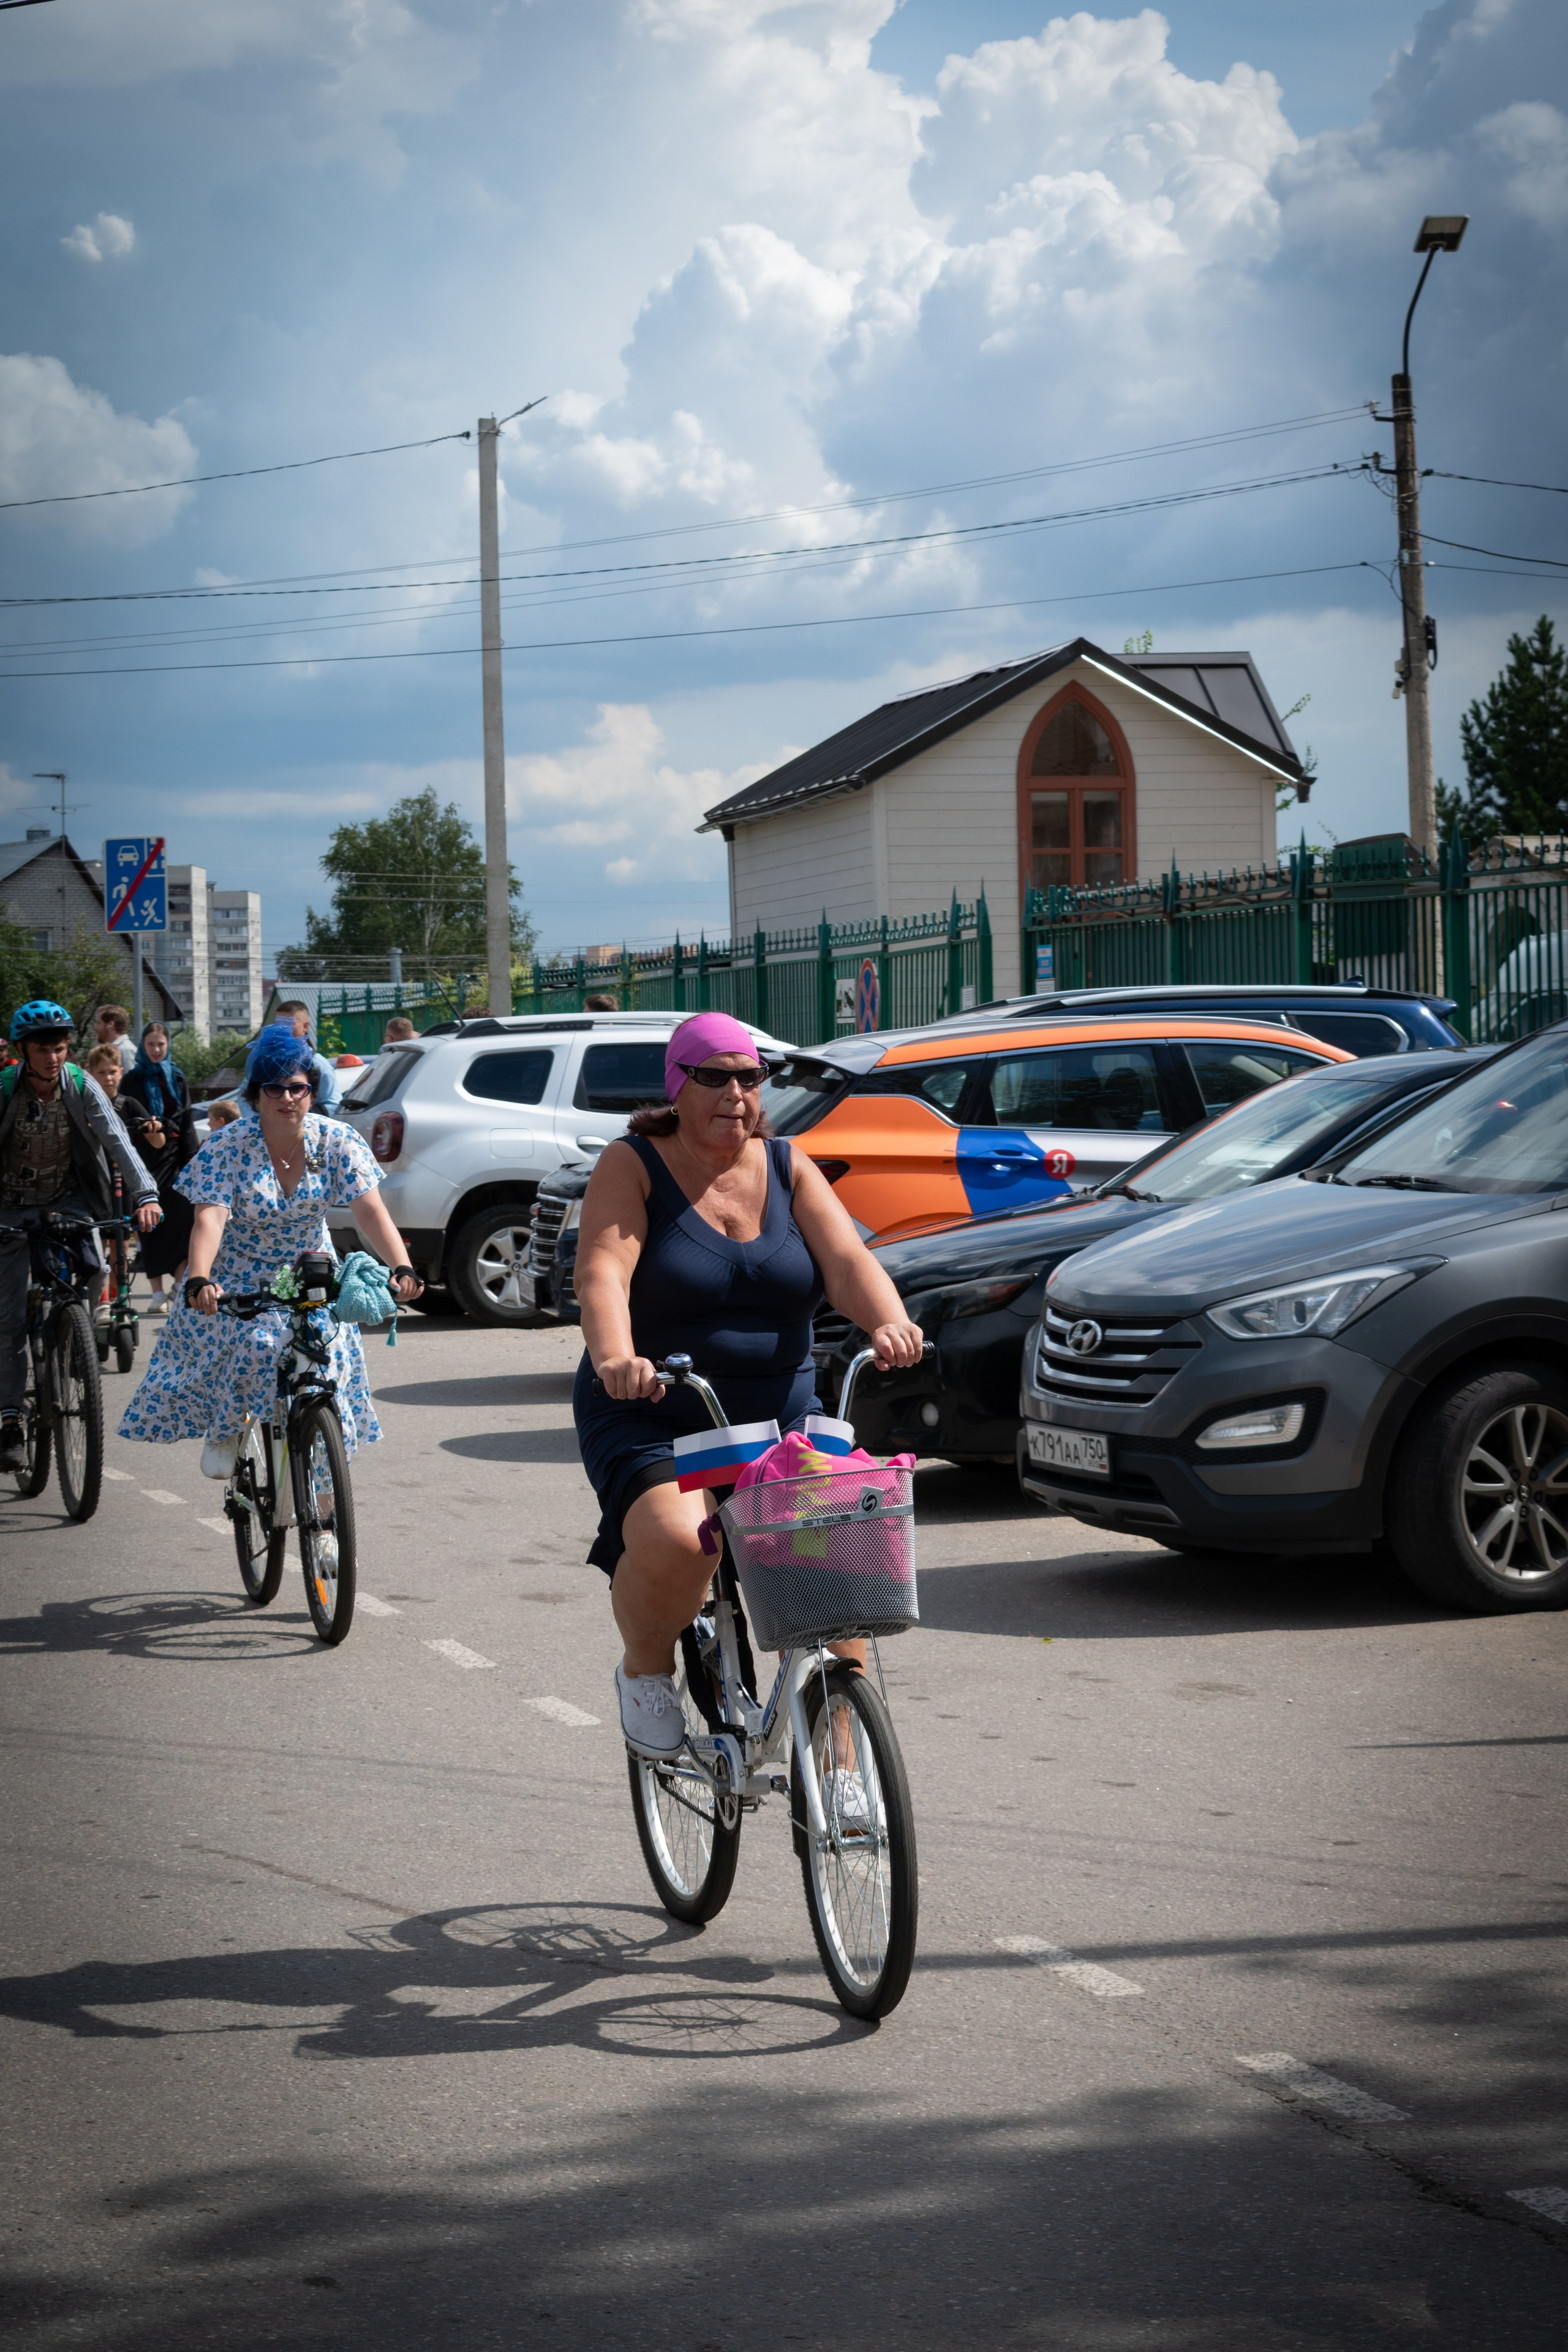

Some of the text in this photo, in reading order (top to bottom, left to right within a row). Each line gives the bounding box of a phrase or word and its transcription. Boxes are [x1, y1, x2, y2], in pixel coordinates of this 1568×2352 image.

[1052, 1153, 1068, 1174] Я
[1081, 1437, 1104, 1461] 750
[1088, 1460, 1099, 1468] RUS
[802, 1514, 851, 1527] STELS
[764, 1713, 776, 1737] STELS
[695, 1739, 715, 1748] PILOT
